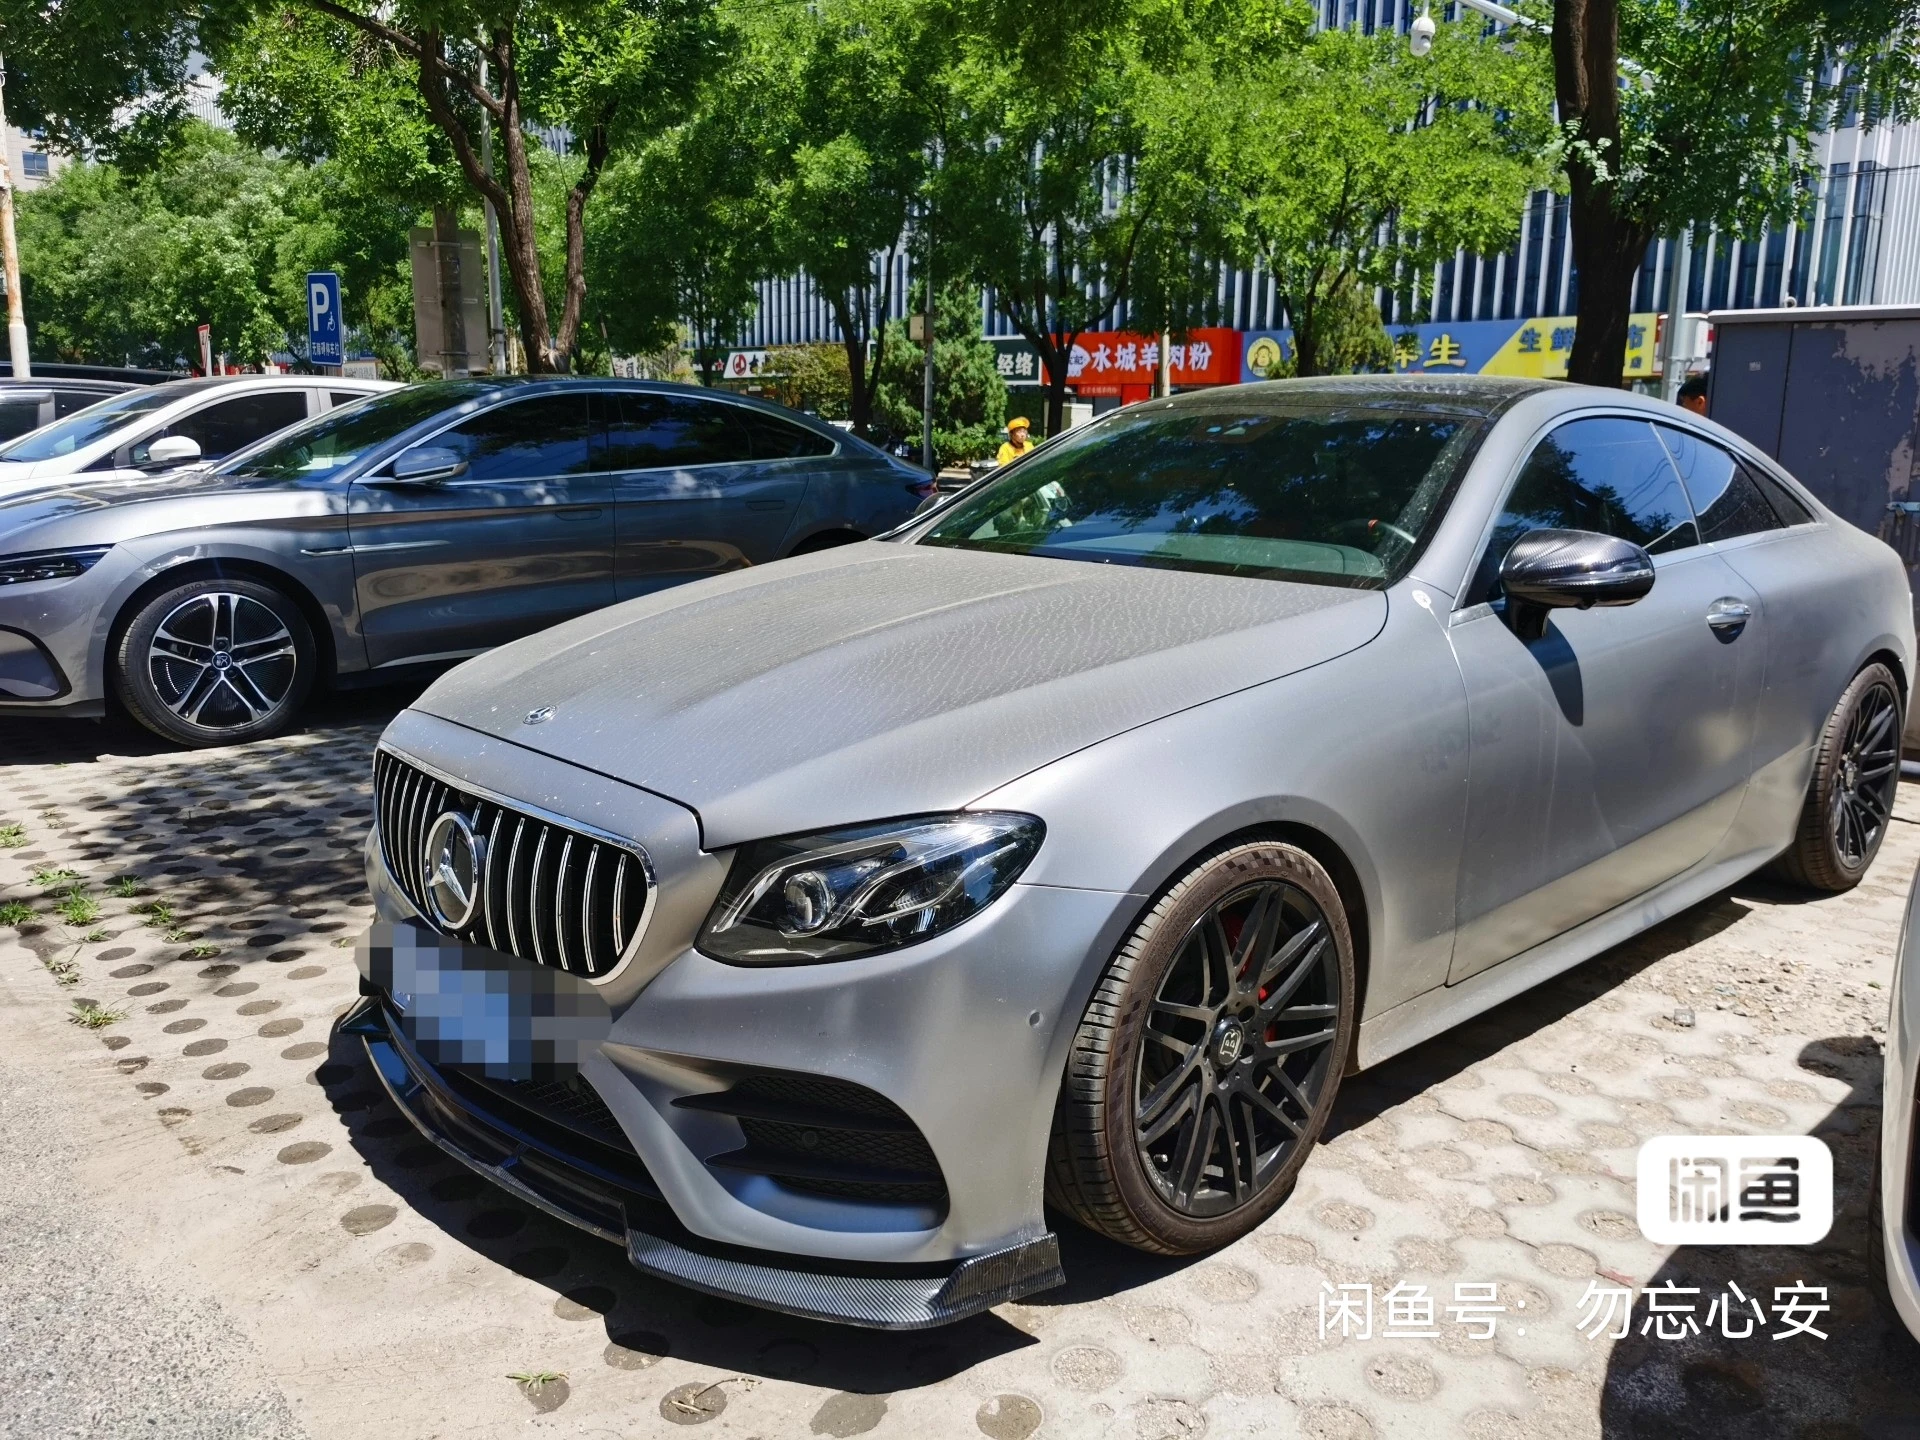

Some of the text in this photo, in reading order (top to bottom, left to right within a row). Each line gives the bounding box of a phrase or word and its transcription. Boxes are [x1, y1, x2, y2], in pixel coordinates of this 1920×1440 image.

[311, 283, 329, 331] P
[312, 341, 340, 356] 无障碍停车位
[1518, 324, 1646, 353] 生鲜市
[997, 351, 1034, 376] 经络
[1090, 341, 1213, 372] 水城羊肉粉
